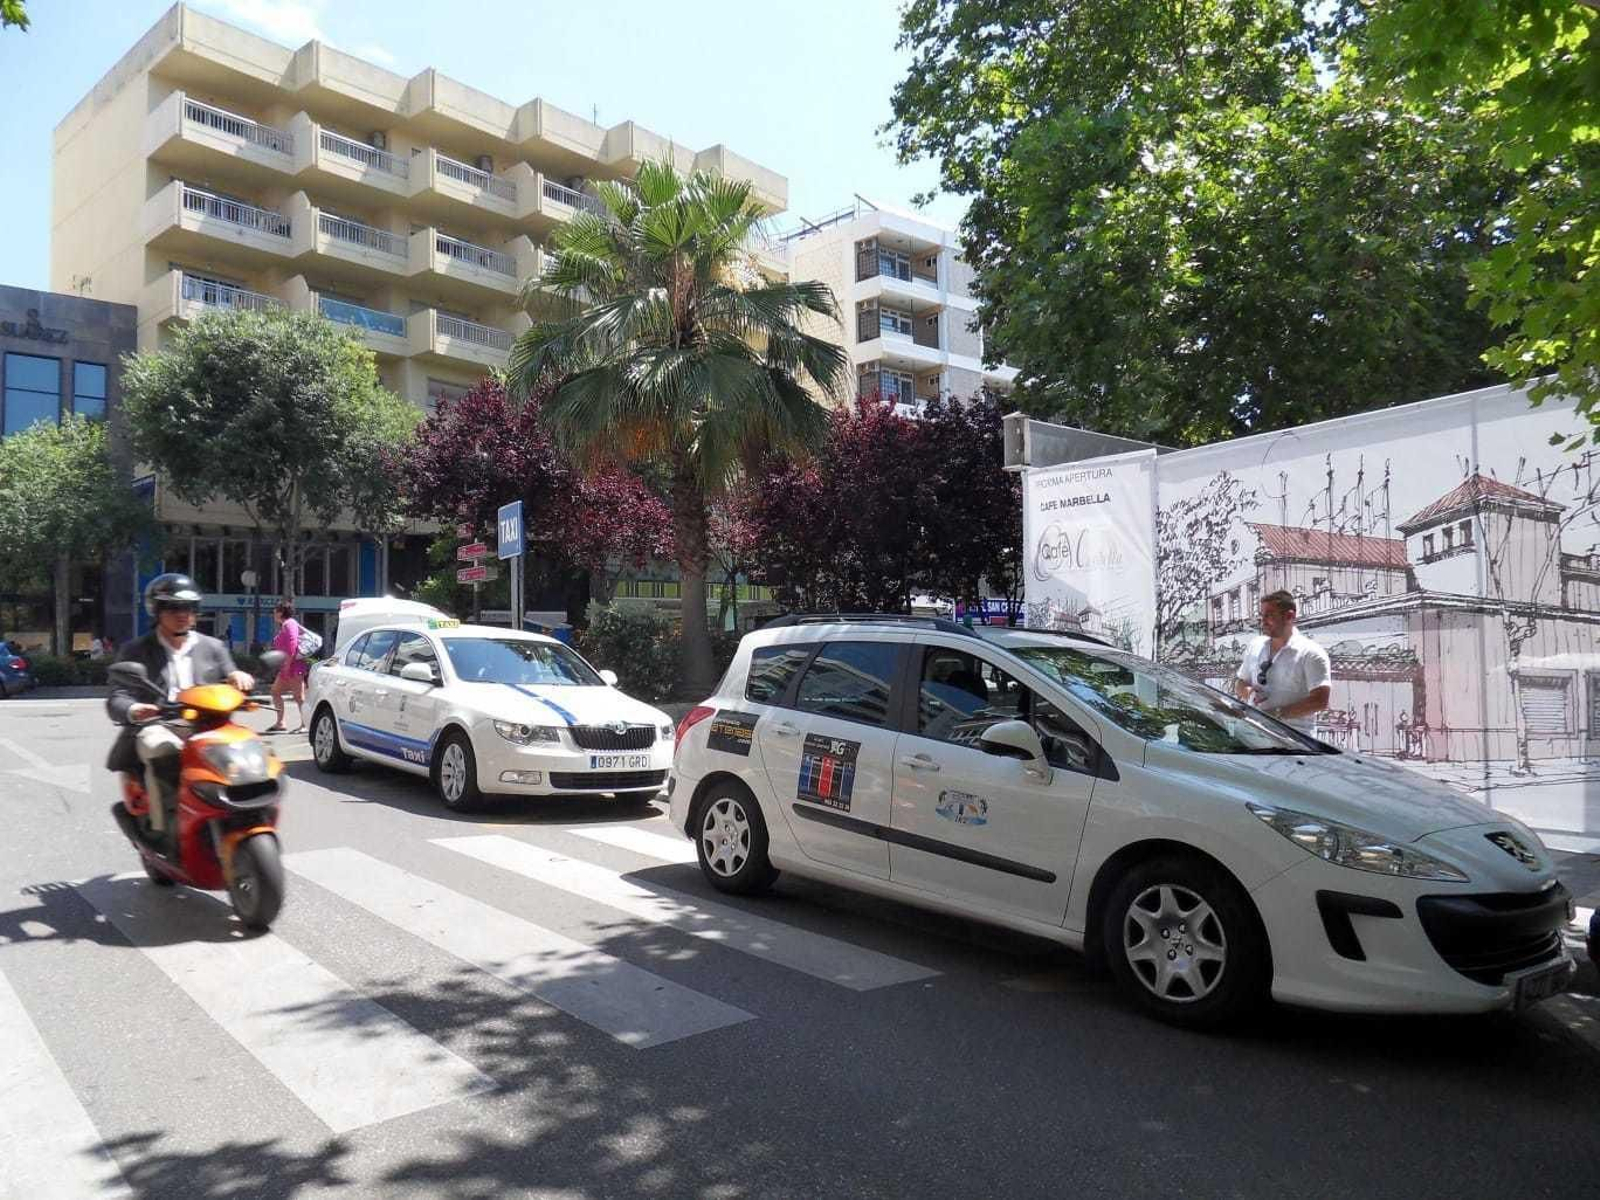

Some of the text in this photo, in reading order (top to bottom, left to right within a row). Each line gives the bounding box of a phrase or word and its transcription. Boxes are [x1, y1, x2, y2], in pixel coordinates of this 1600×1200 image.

[1040, 492, 1111, 512] CAFE MARBELLA
[500, 516, 518, 543] TAXI
[440, 620, 458, 629] TAXI
[401, 747, 425, 763] Taxi
[598, 755, 648, 768] 0971 GRD
